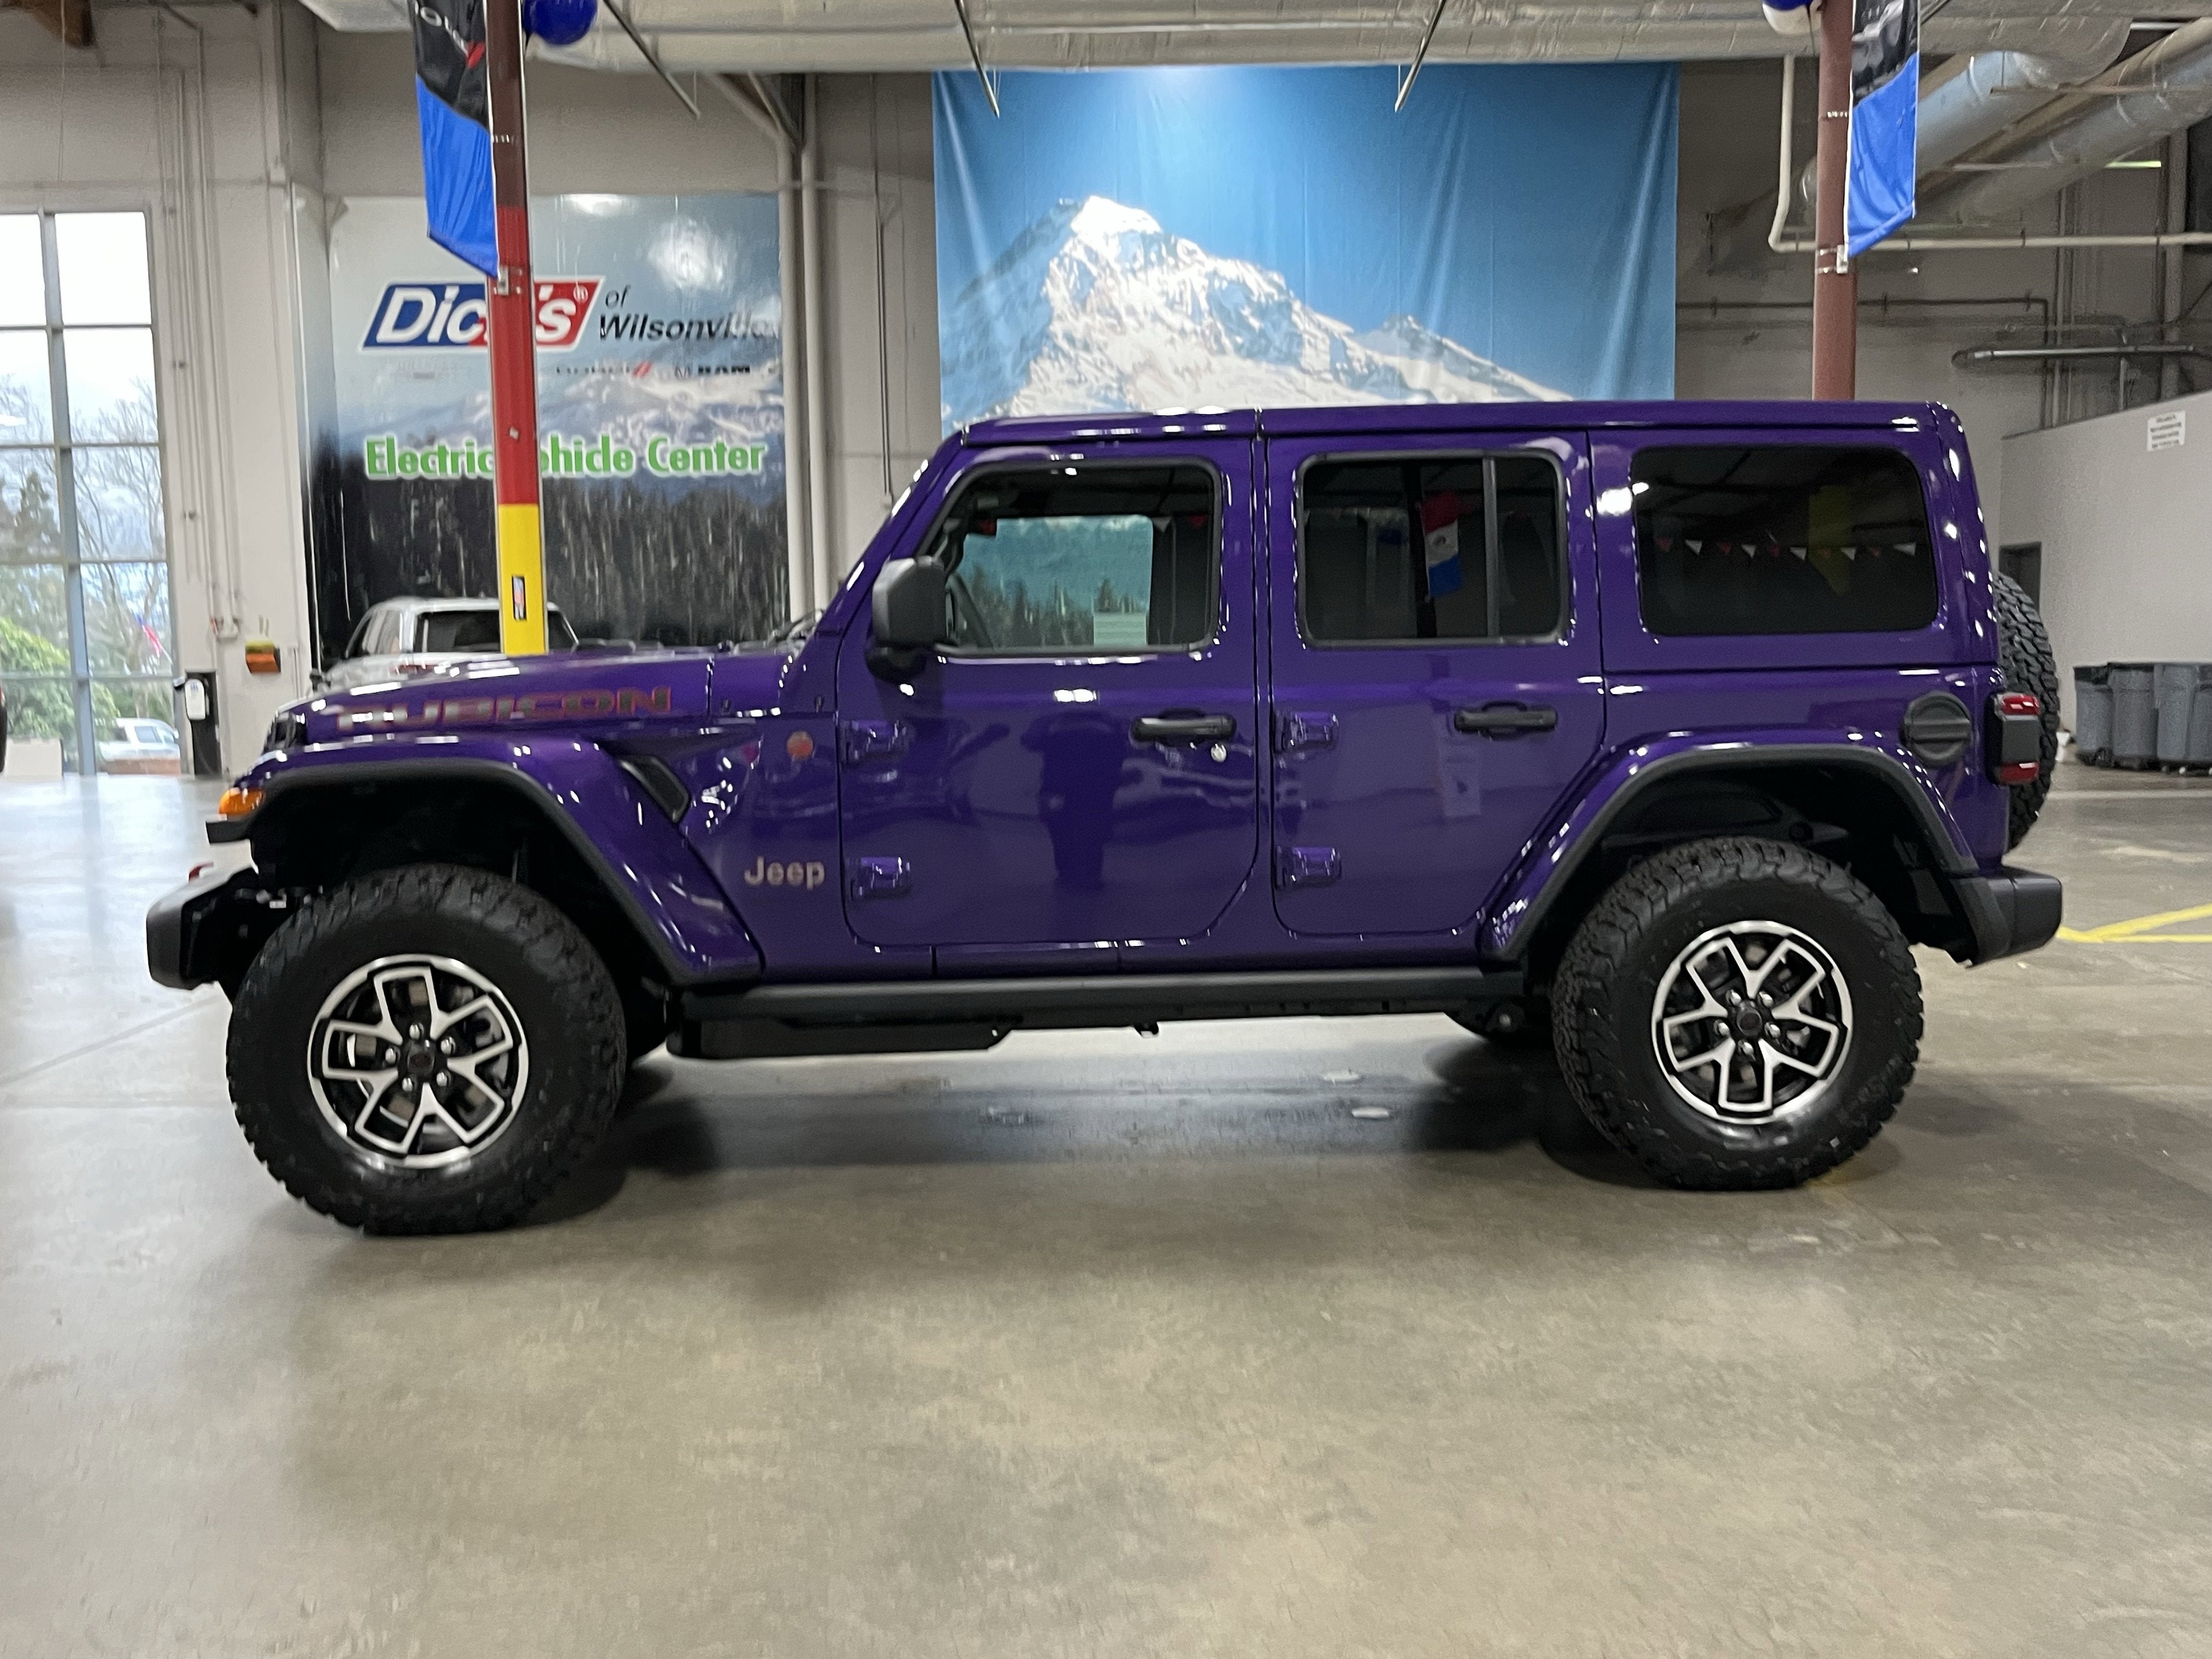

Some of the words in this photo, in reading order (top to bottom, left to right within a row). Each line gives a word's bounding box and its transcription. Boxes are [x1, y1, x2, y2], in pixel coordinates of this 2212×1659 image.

[376, 285, 577, 343] Dic's
[605, 284, 630, 308] of
[366, 435, 494, 477] Electric
[648, 436, 766, 473] Center
[336, 687, 672, 731] RUBICON
[744, 855, 825, 890] Jeep
